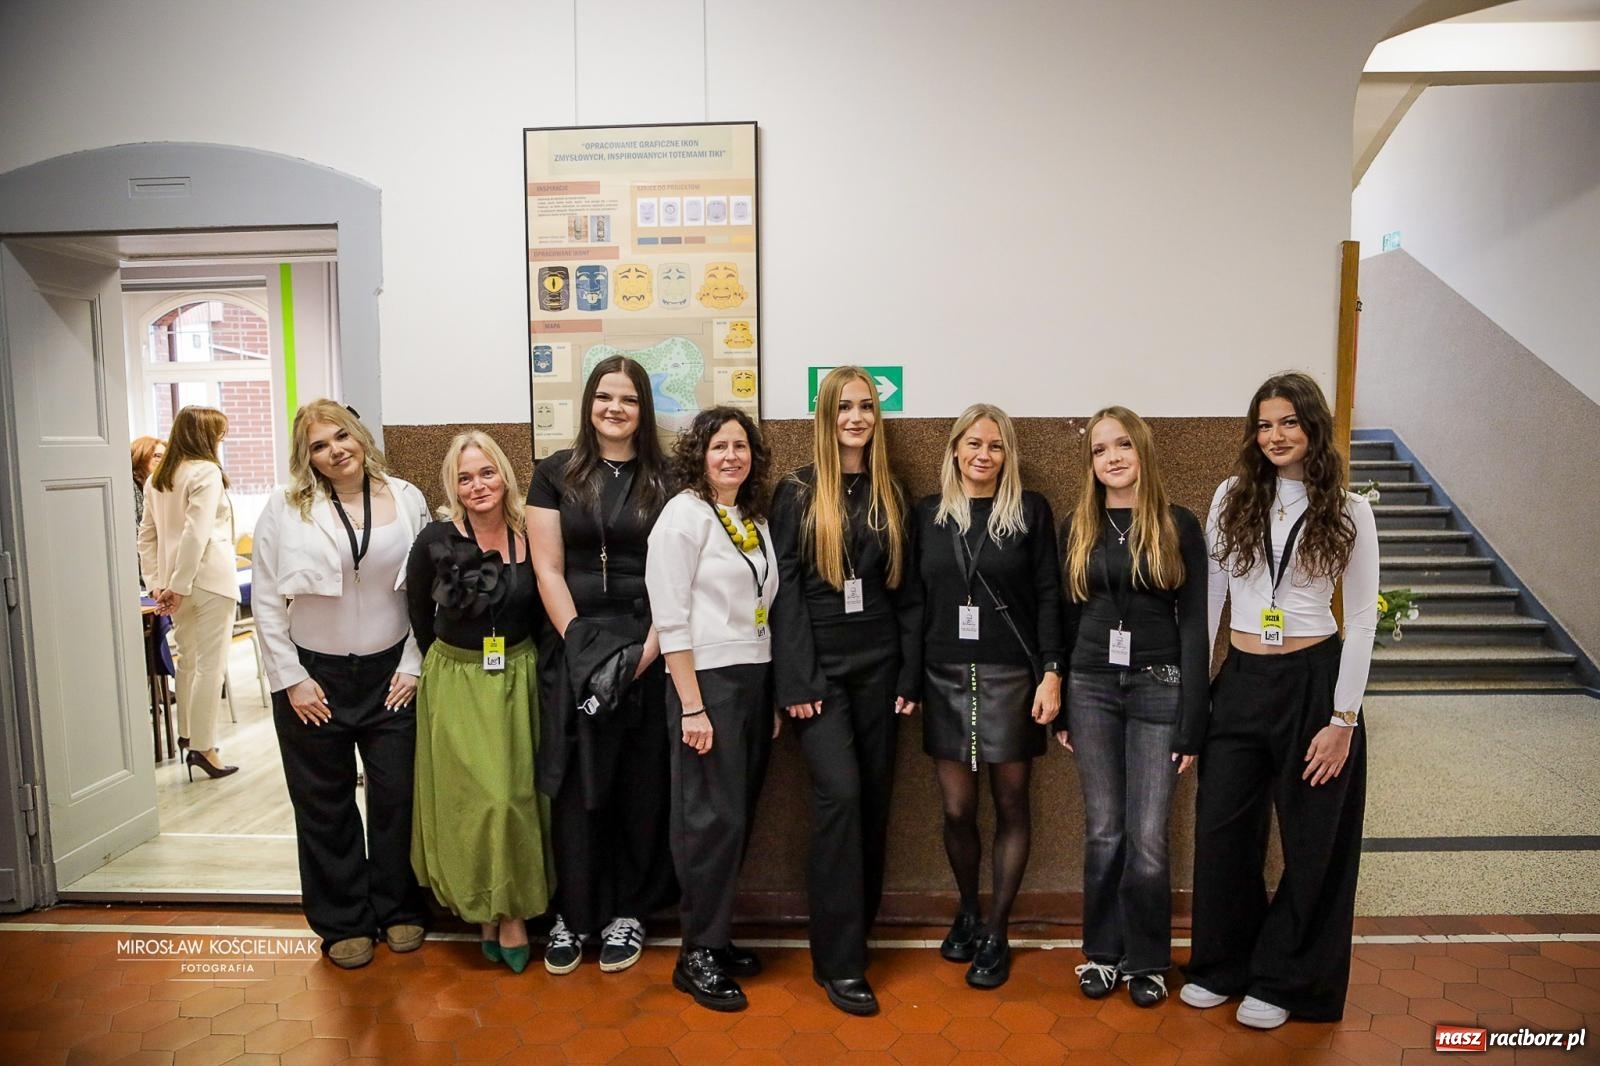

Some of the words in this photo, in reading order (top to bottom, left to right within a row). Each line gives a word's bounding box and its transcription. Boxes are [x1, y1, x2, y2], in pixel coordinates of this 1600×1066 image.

[639, 140, 680, 149] GRAFICZNE
[681, 139, 699, 147] IKON
[607, 152, 668, 160] INSPIROWANYCH
[669, 151, 707, 159] TOTEMAMI
